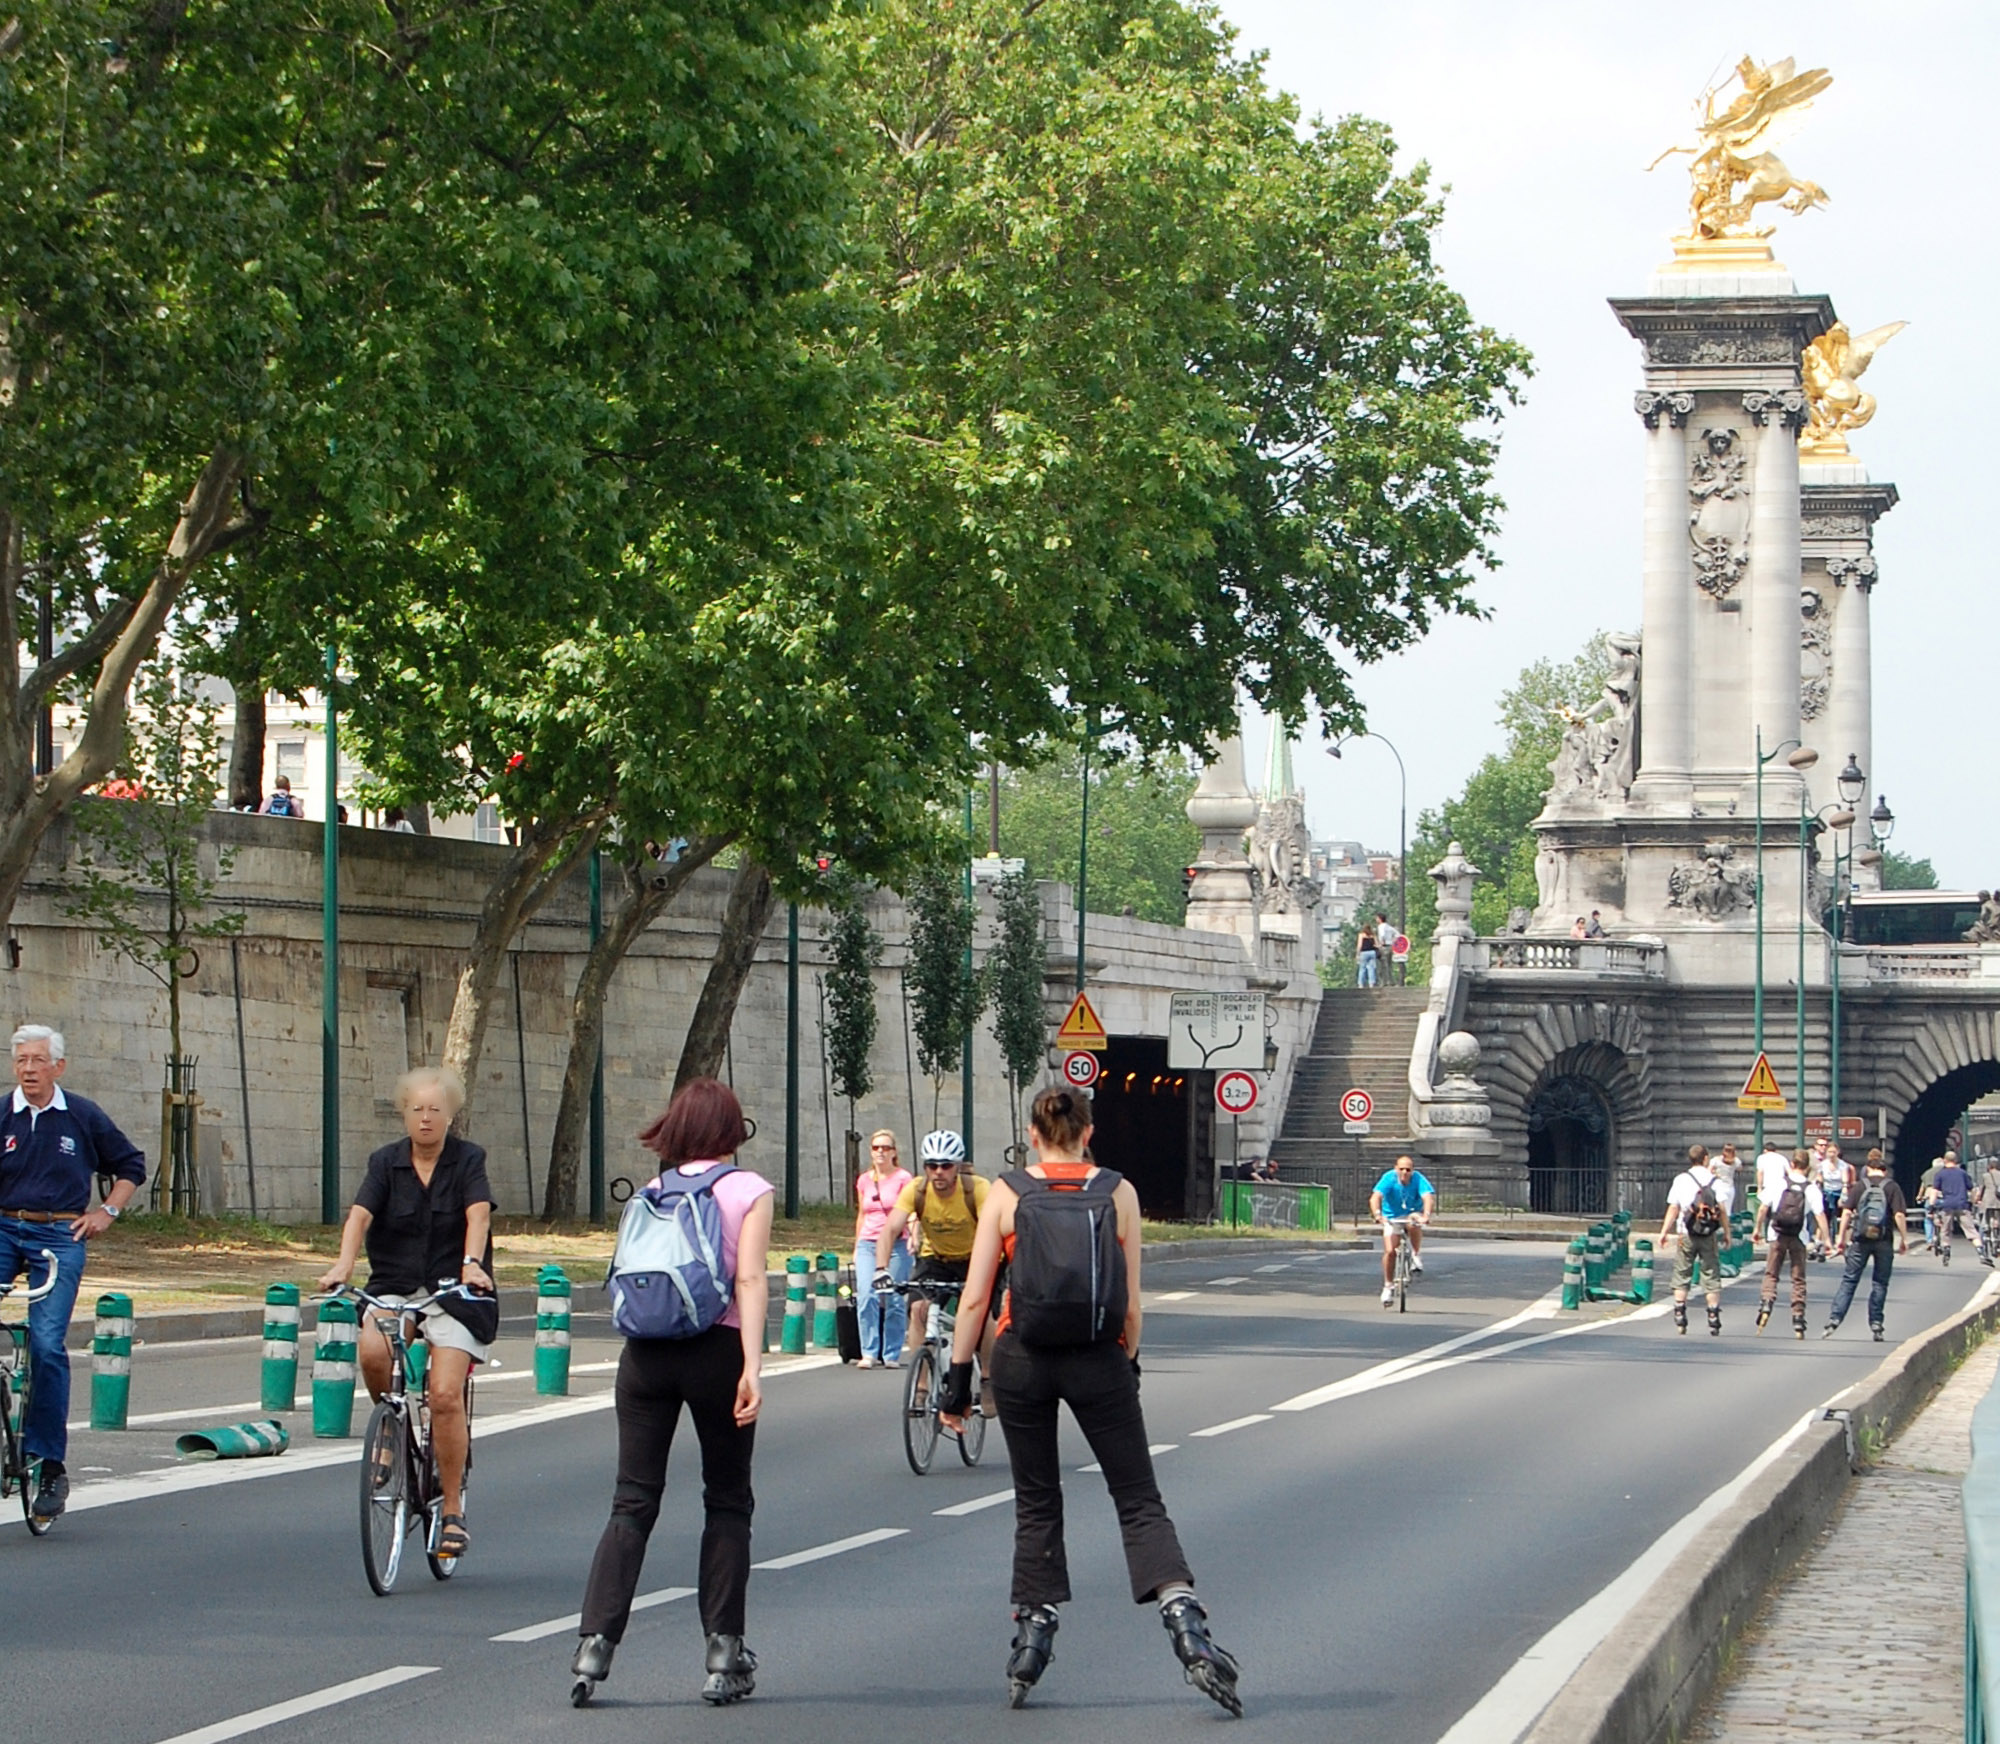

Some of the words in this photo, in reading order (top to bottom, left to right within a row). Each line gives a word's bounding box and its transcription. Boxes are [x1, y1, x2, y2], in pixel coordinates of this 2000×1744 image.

[1223, 1004, 1241, 1012] PONT
[1247, 1004, 1256, 1012] DE
[1071, 1061, 1091, 1076] 50
[1348, 1099, 1366, 1112] 50
